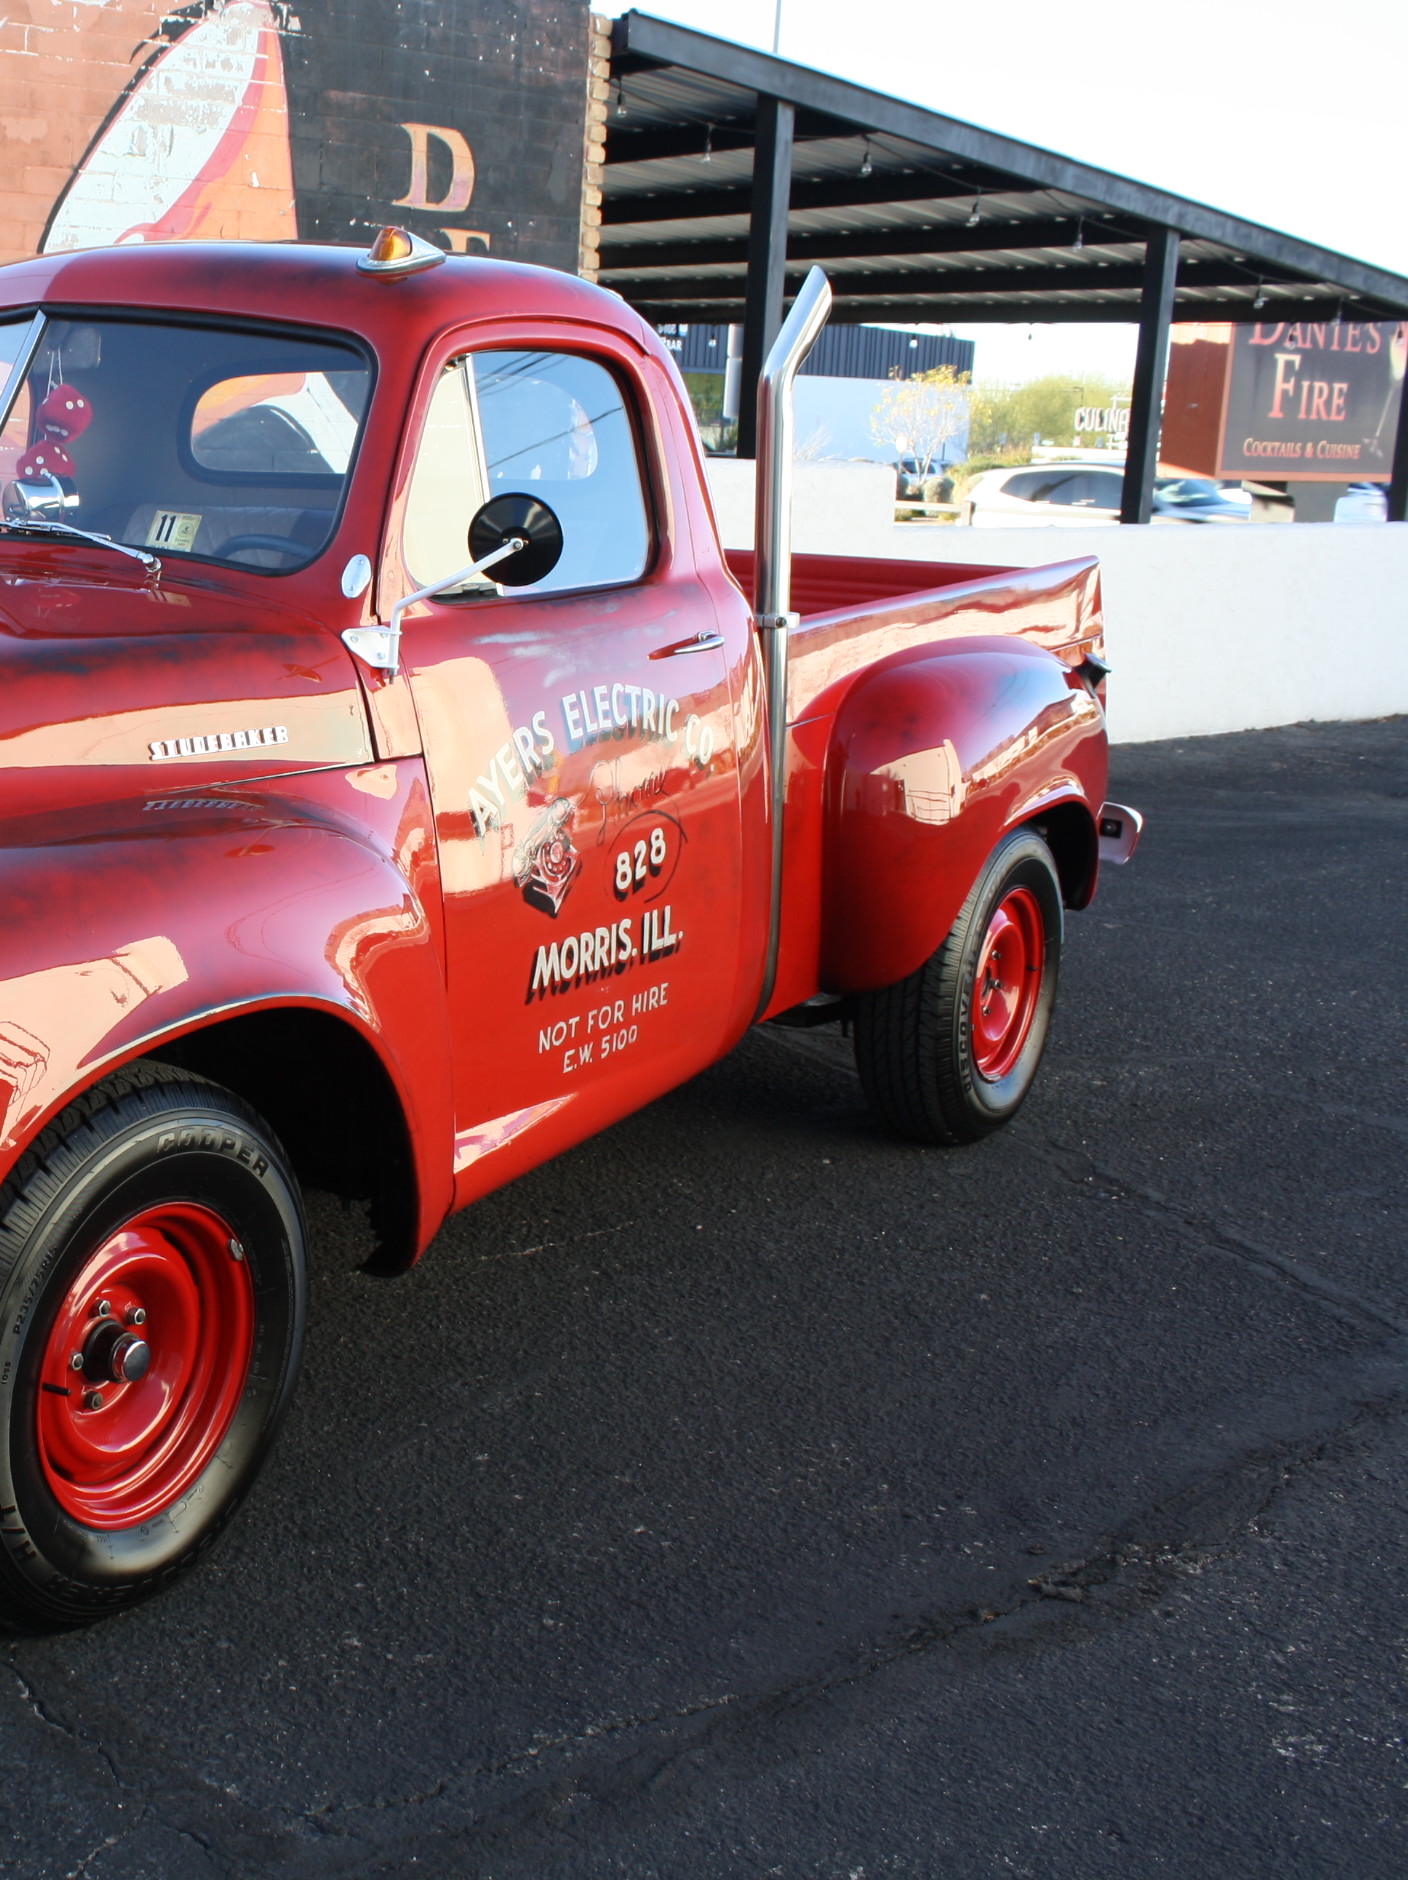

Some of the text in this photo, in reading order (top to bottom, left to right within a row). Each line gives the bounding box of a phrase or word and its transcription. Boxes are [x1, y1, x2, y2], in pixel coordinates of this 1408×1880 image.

[392, 122, 476, 212] D
[1268, 353, 1348, 421] FIRE
[1243, 438, 1362, 460] COCKTAILS & CUISINE
[155, 514, 177, 542] 11
[148, 725, 289, 761] STUDEBAKER
[468, 710, 556, 838] AYERS
[562, 683, 680, 743] ELECTRIC
[615, 827, 667, 891] 828
[643, 905, 684, 955] ILL.
[538, 982, 669, 1054] NOT FOR HIRE
[601, 1025, 638, 1059] 5100
[156, 1127, 270, 1179] COOPER
